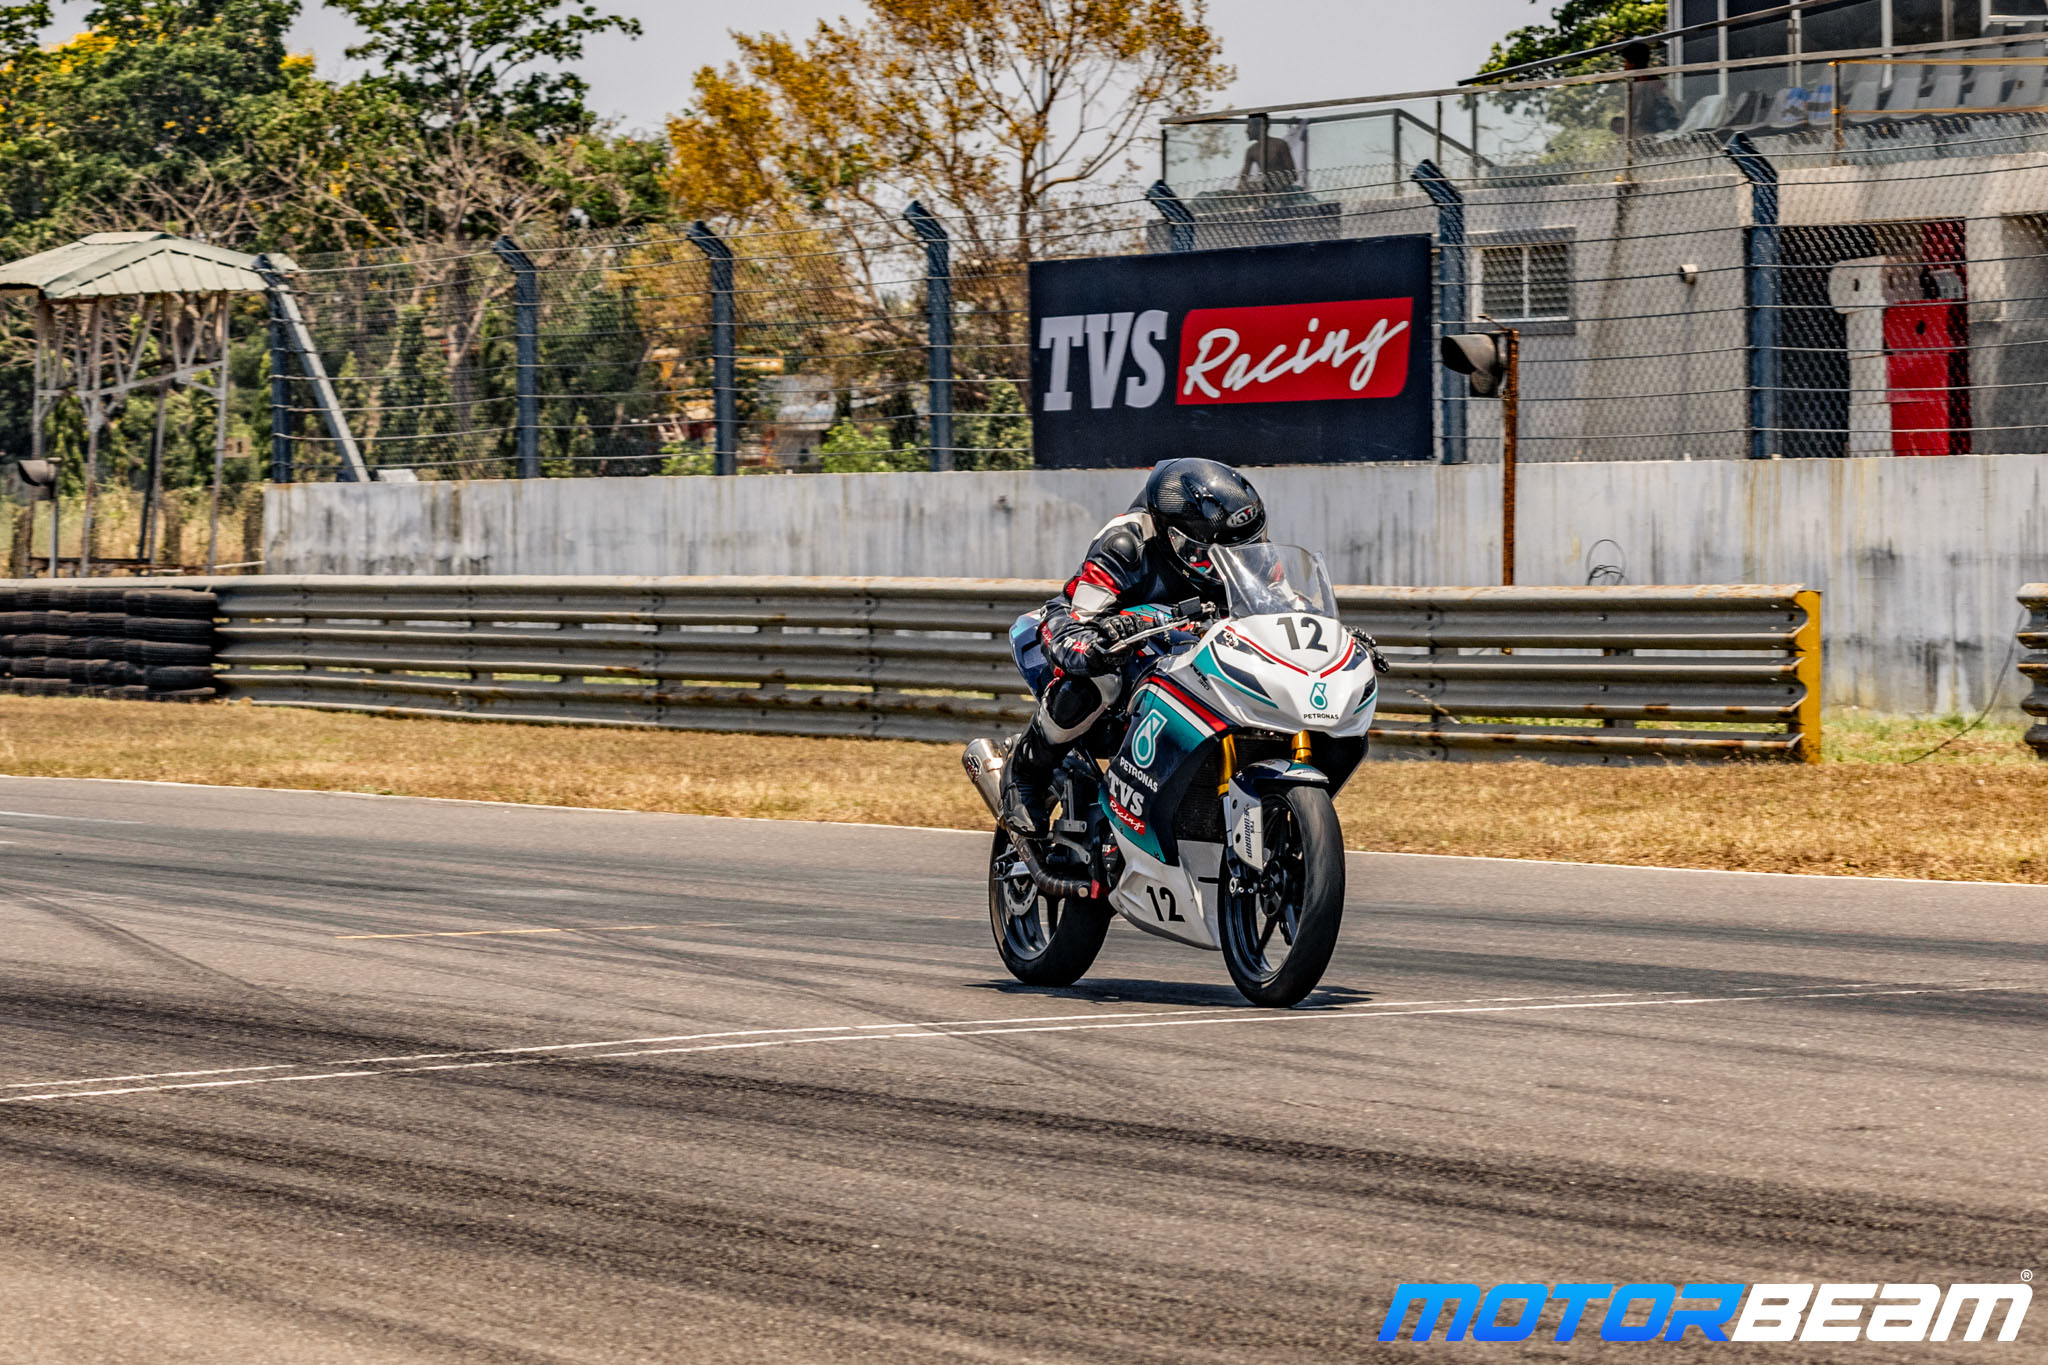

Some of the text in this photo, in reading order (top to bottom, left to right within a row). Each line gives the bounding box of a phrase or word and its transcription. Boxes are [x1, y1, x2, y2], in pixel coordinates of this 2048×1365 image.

[1039, 310, 1409, 411] TVS Racing
[1276, 616, 1328, 652] 12
[1108, 769, 1145, 816] TVS
[1120, 757, 1158, 793] PETRONAS
[1109, 799, 1144, 830] Racing
[1146, 885, 1185, 923] 12
